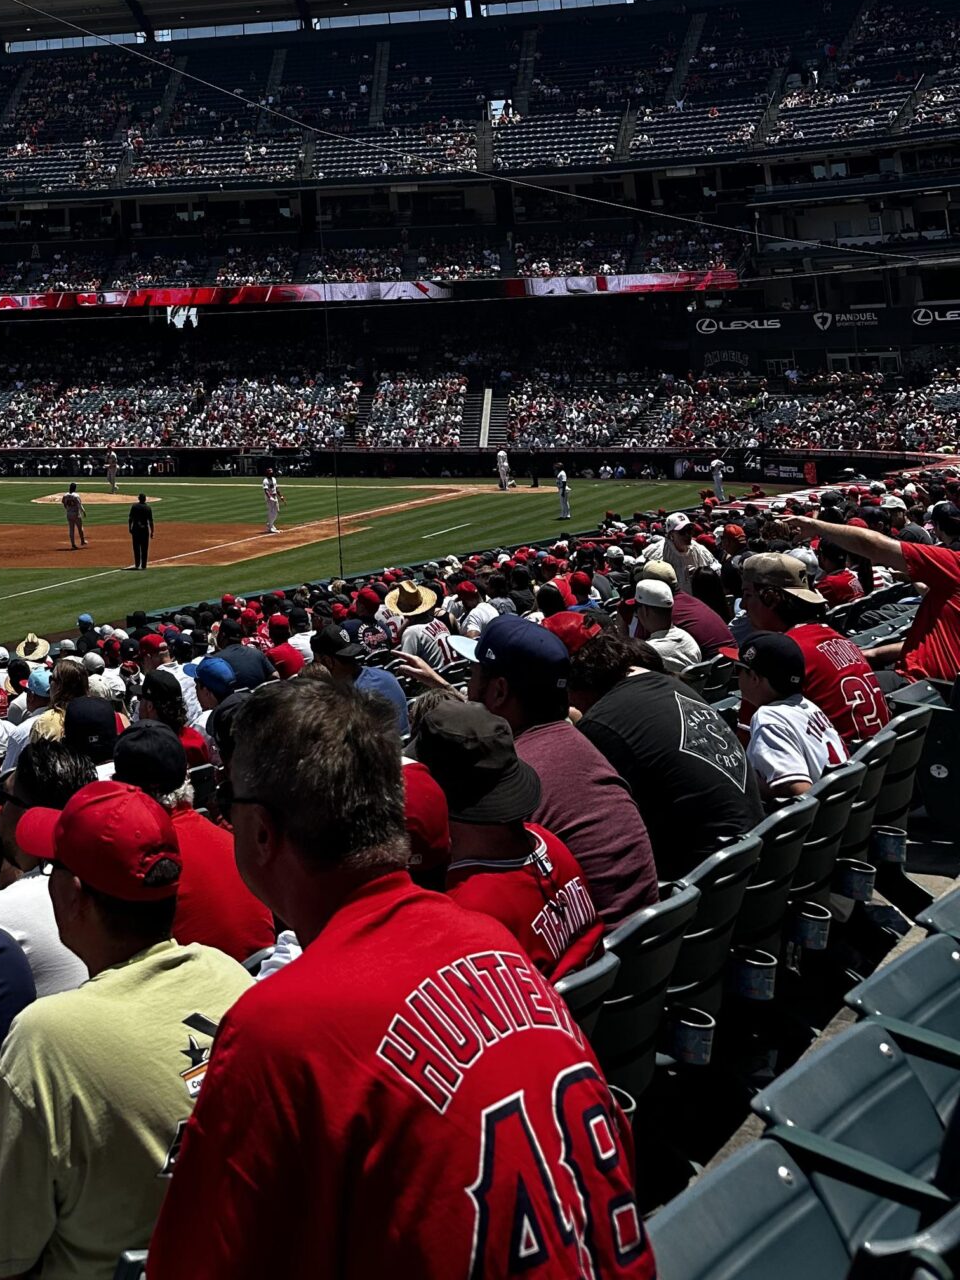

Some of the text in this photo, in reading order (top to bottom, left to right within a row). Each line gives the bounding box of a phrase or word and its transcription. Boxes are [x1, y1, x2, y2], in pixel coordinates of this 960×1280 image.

[719, 319, 781, 330] LEXUS
[836, 312, 878, 322] FANDUEL
[704, 350, 749, 367] ANGELS
[694, 465, 735, 473] KUHO
[687, 709, 719, 730] SALTY
[715, 747, 743, 768] CREW
[464, 1061, 658, 1280] 48
